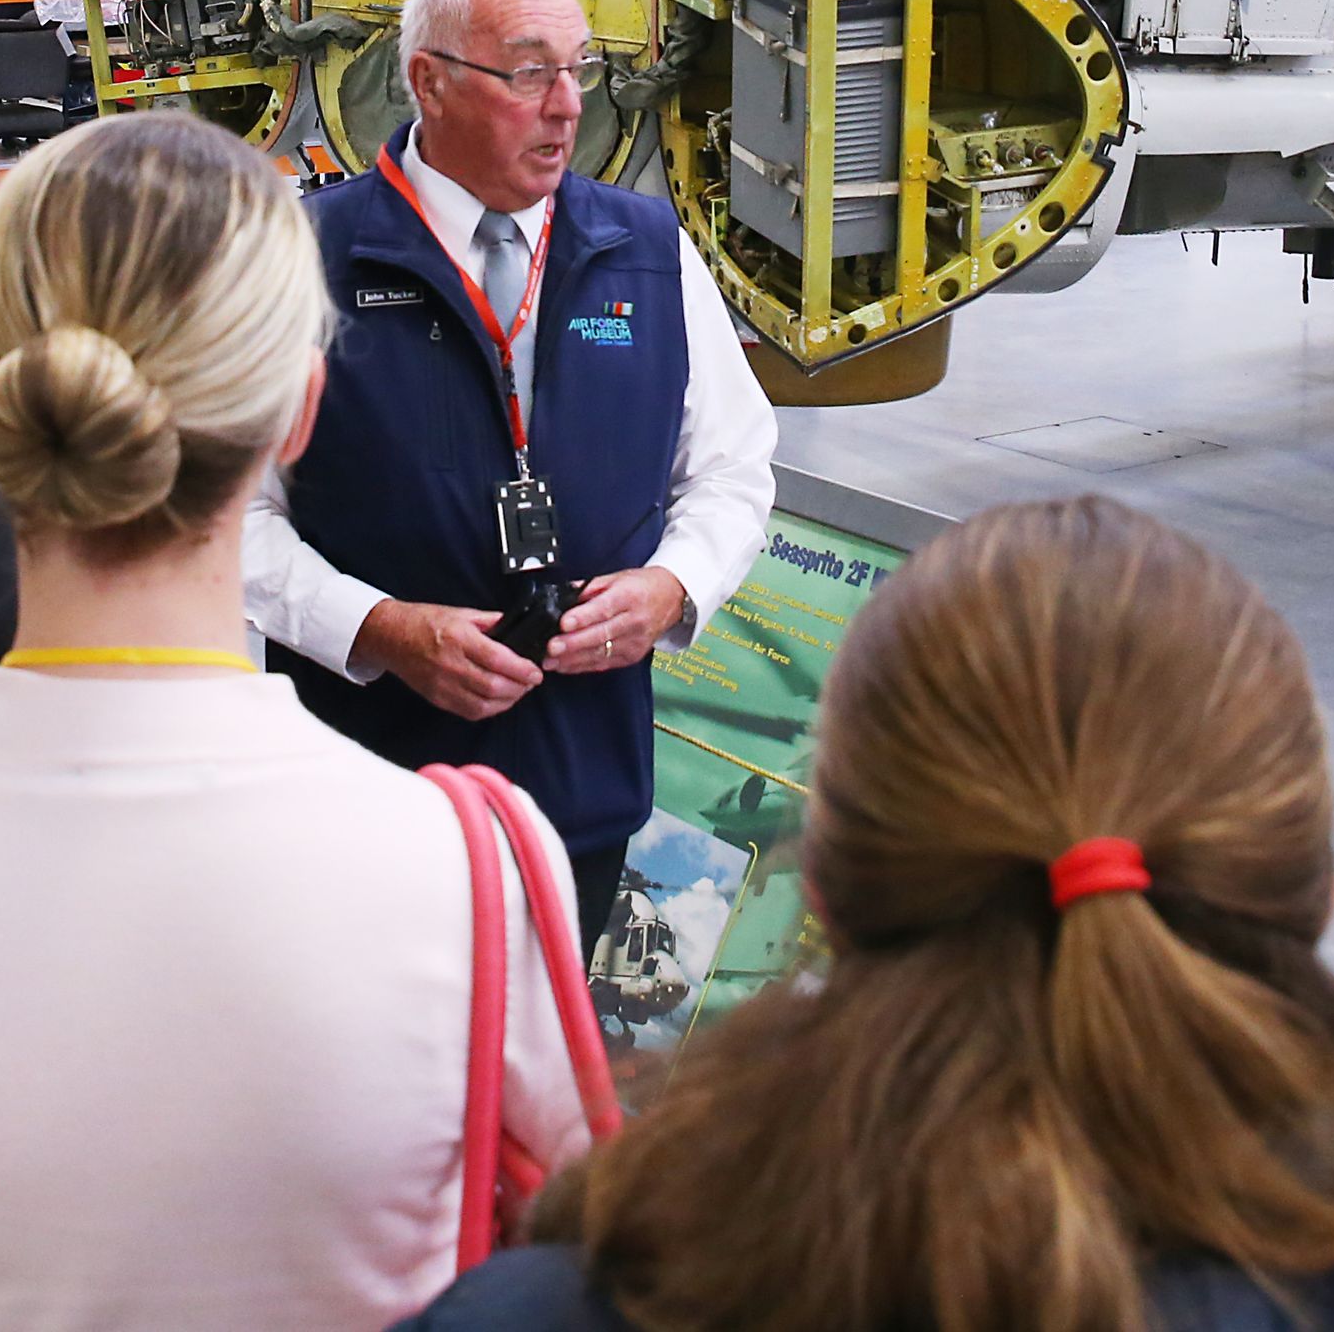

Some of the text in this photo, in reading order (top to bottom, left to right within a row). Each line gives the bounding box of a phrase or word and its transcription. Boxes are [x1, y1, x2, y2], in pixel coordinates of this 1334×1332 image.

[365, 293, 385, 303] John
[568, 317, 628, 330] AIR FORCE
[581, 328, 632, 341] MUSEUM
[769, 532, 844, 580] Seasprite
[753, 642, 767, 654] Air
[767, 647, 791, 665] Force
